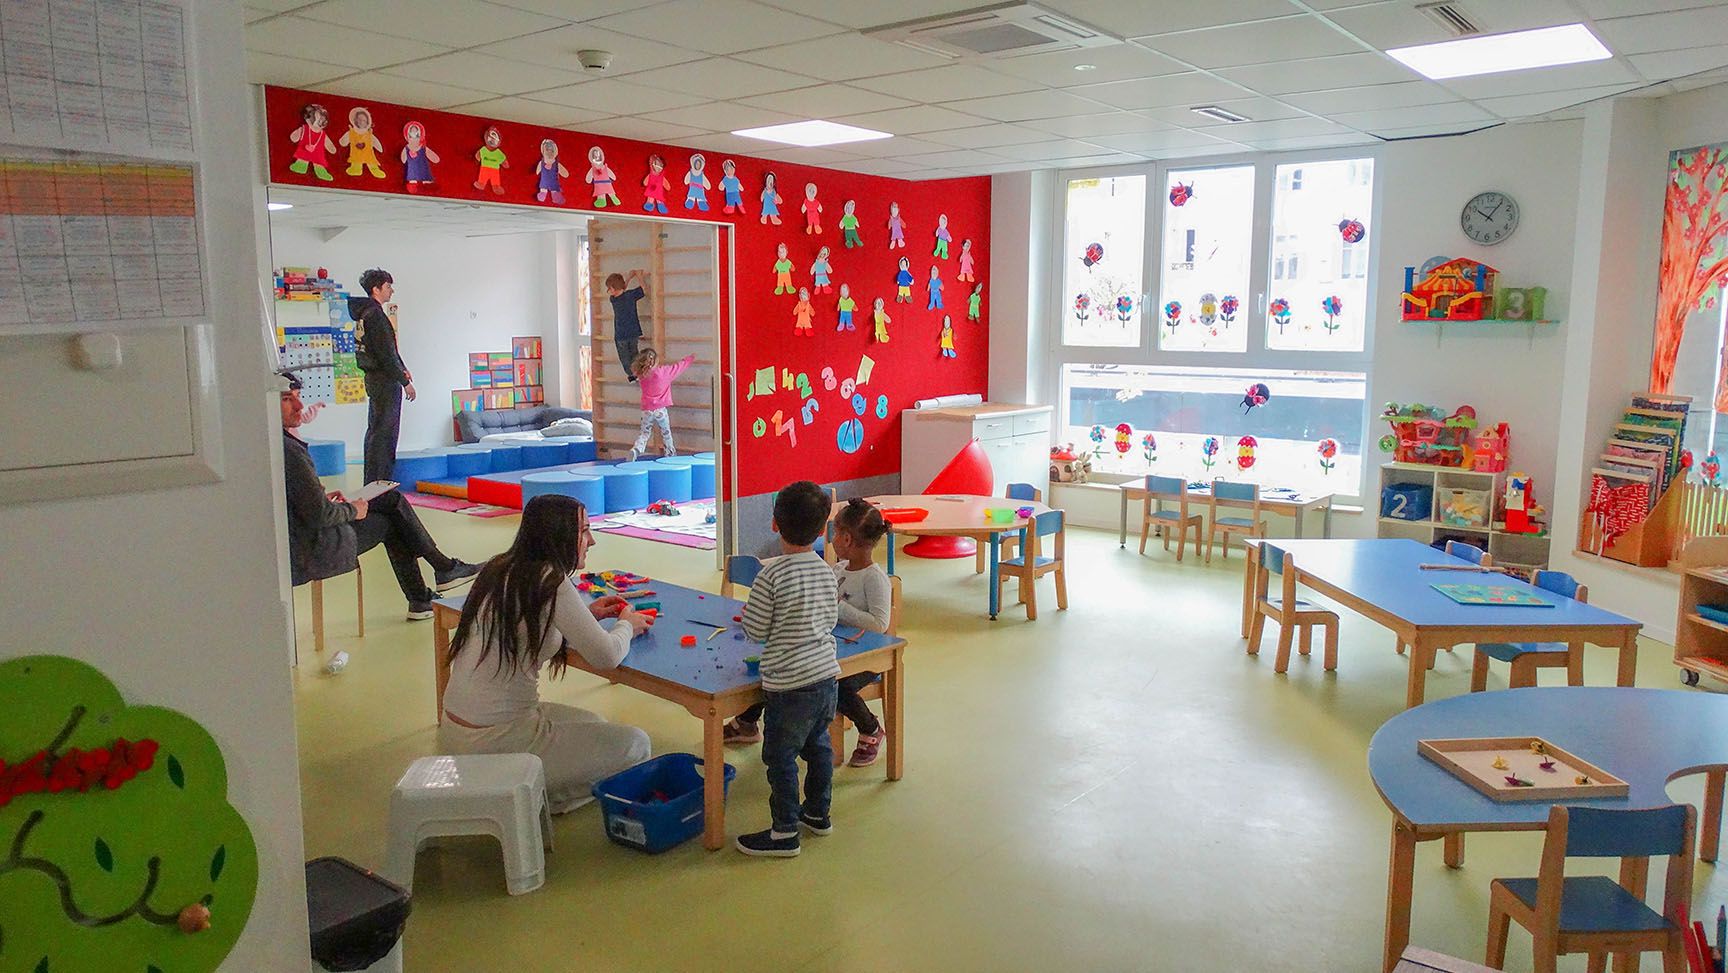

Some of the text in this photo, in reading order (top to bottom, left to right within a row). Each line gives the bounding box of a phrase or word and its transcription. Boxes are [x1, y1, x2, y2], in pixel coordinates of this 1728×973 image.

[1486, 195, 1495, 203] 12
[1507, 213, 1513, 221] 3
[1495, 230, 1501, 238] 5
[796, 373, 813, 399] 2
[821, 366, 838, 391] 3
[875, 394, 888, 420] 8
[771, 409, 783, 437] 1
[1390, 493, 1407, 518] 2
